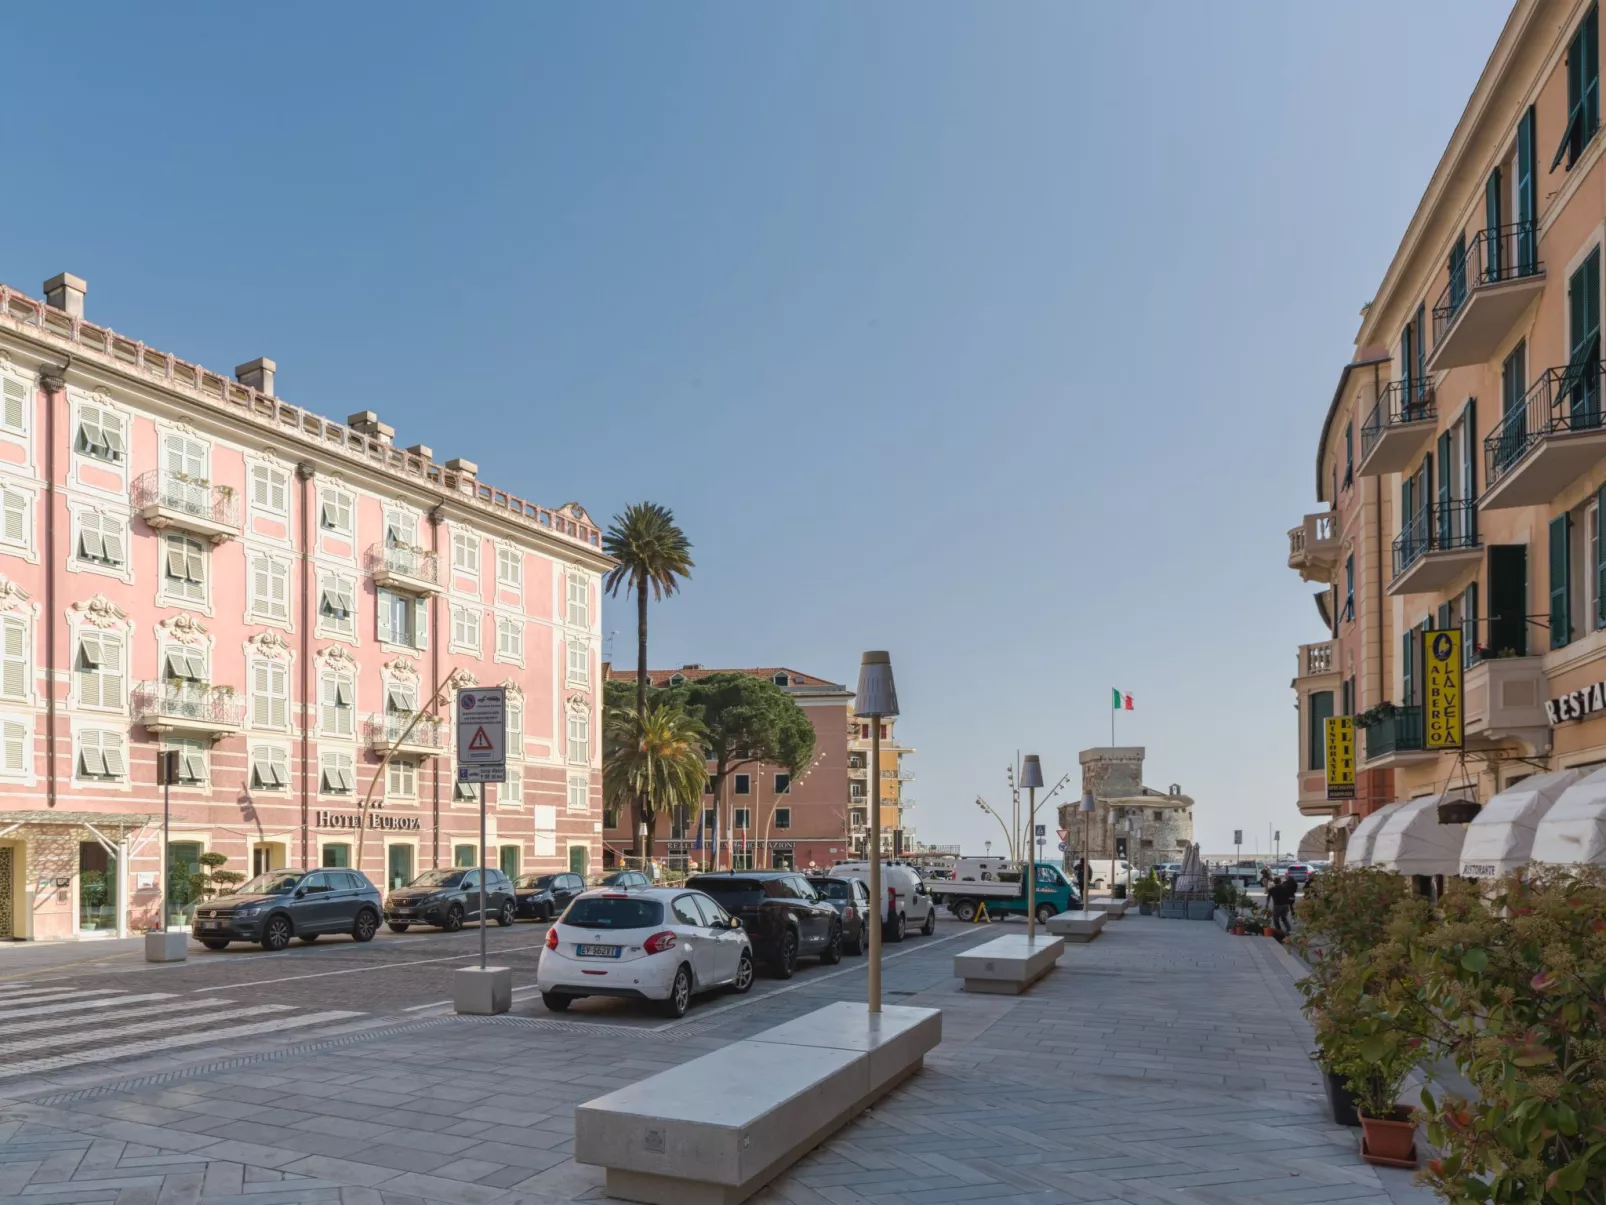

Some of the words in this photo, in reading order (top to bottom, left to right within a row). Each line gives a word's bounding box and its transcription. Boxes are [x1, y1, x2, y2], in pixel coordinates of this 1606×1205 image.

[1443, 661, 1457, 688] LA
[1431, 665, 1442, 742] ALBERGO
[1443, 693, 1457, 744] VELA
[1544, 680, 1606, 725] RESTA
[1329, 719, 1337, 783] RISTORANTE
[1341, 719, 1353, 782] ELITE
[370, 812, 420, 829] EUROPA
